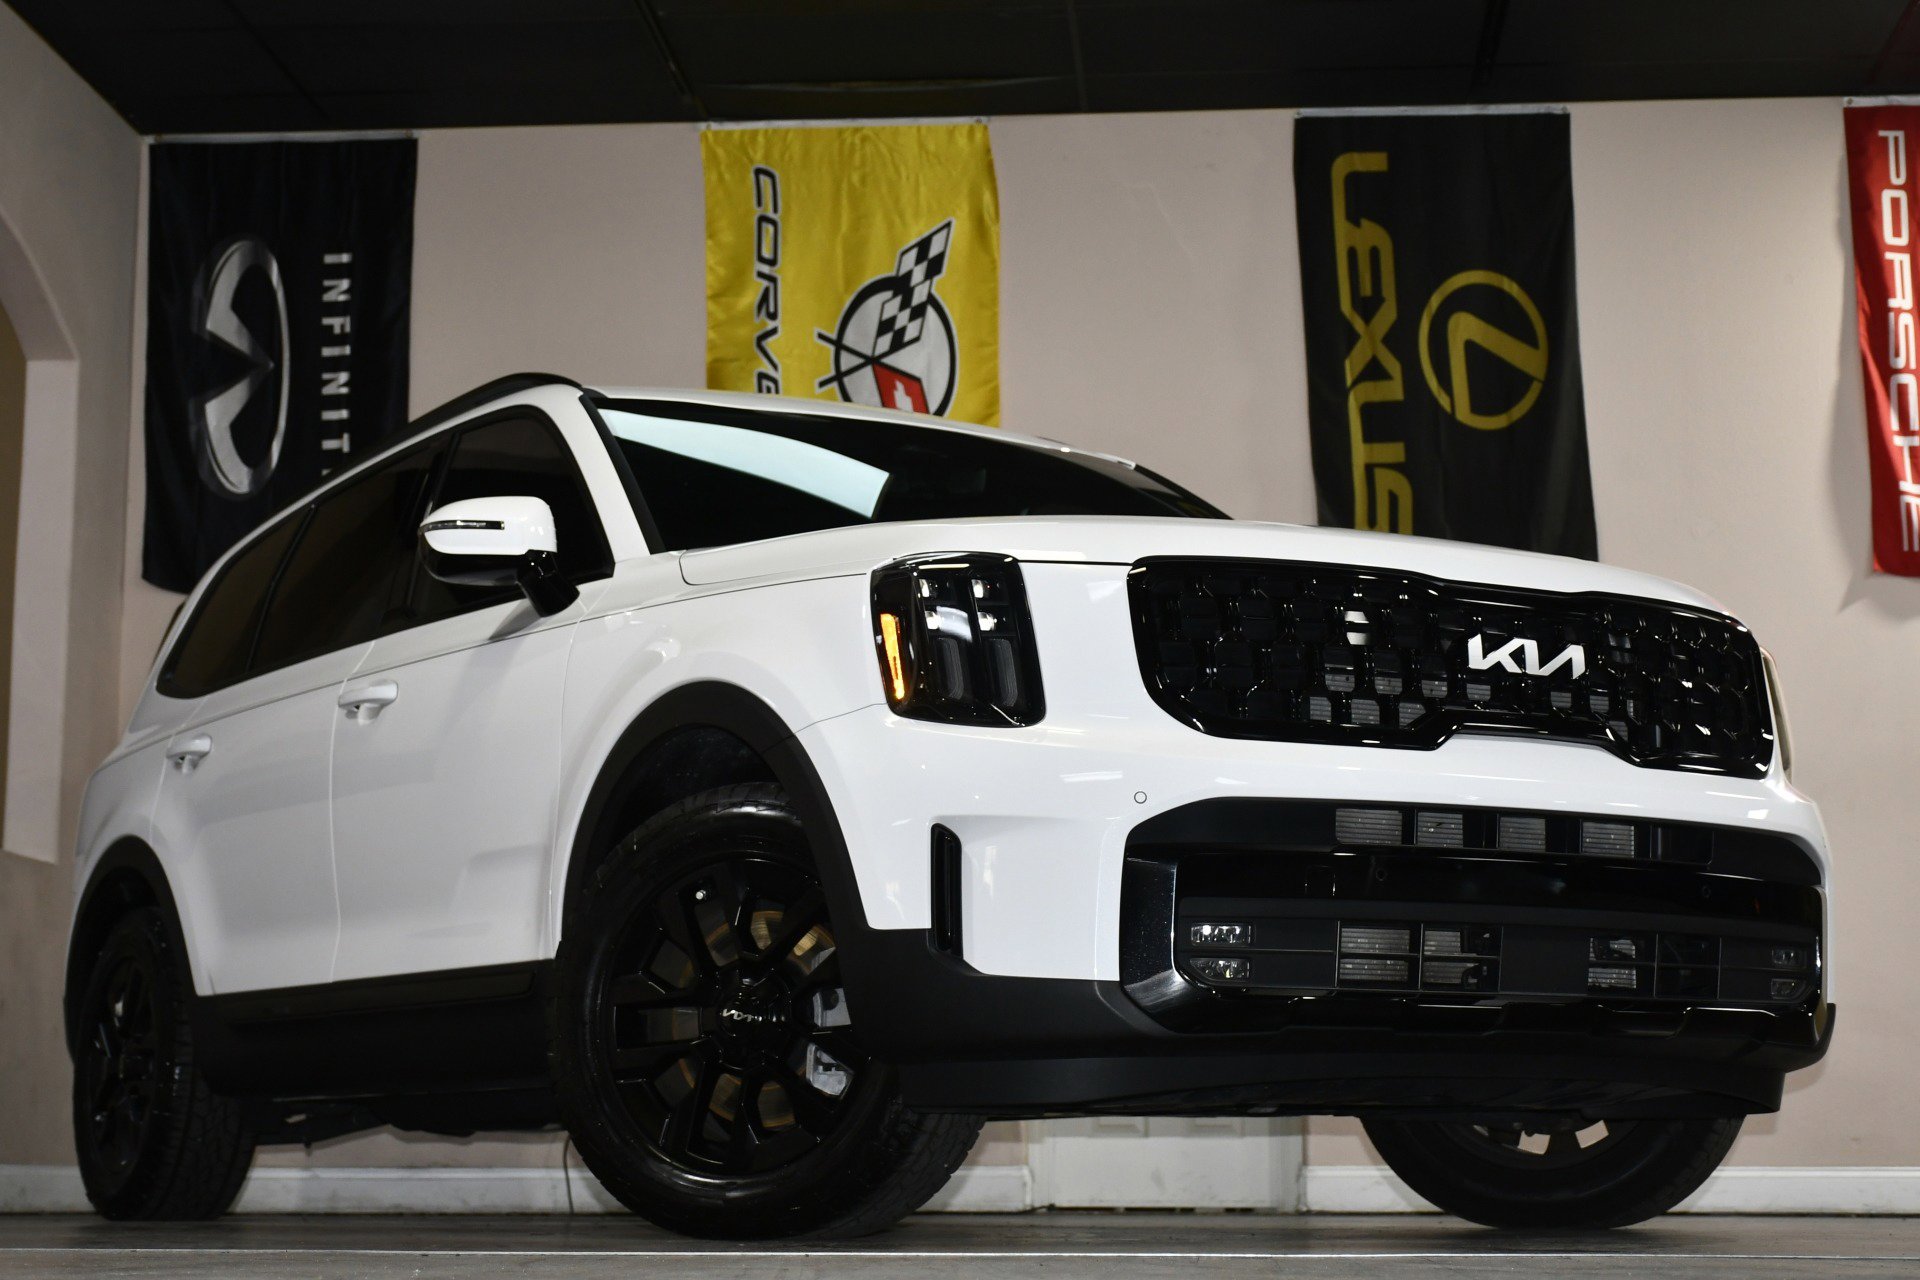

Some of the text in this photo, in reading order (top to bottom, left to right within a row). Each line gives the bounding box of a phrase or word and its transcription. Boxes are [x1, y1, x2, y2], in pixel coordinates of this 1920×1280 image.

[322, 252, 353, 476] INFINIT
[1331, 152, 1413, 535] LEXUS
[1468, 633, 1586, 680] KIA
